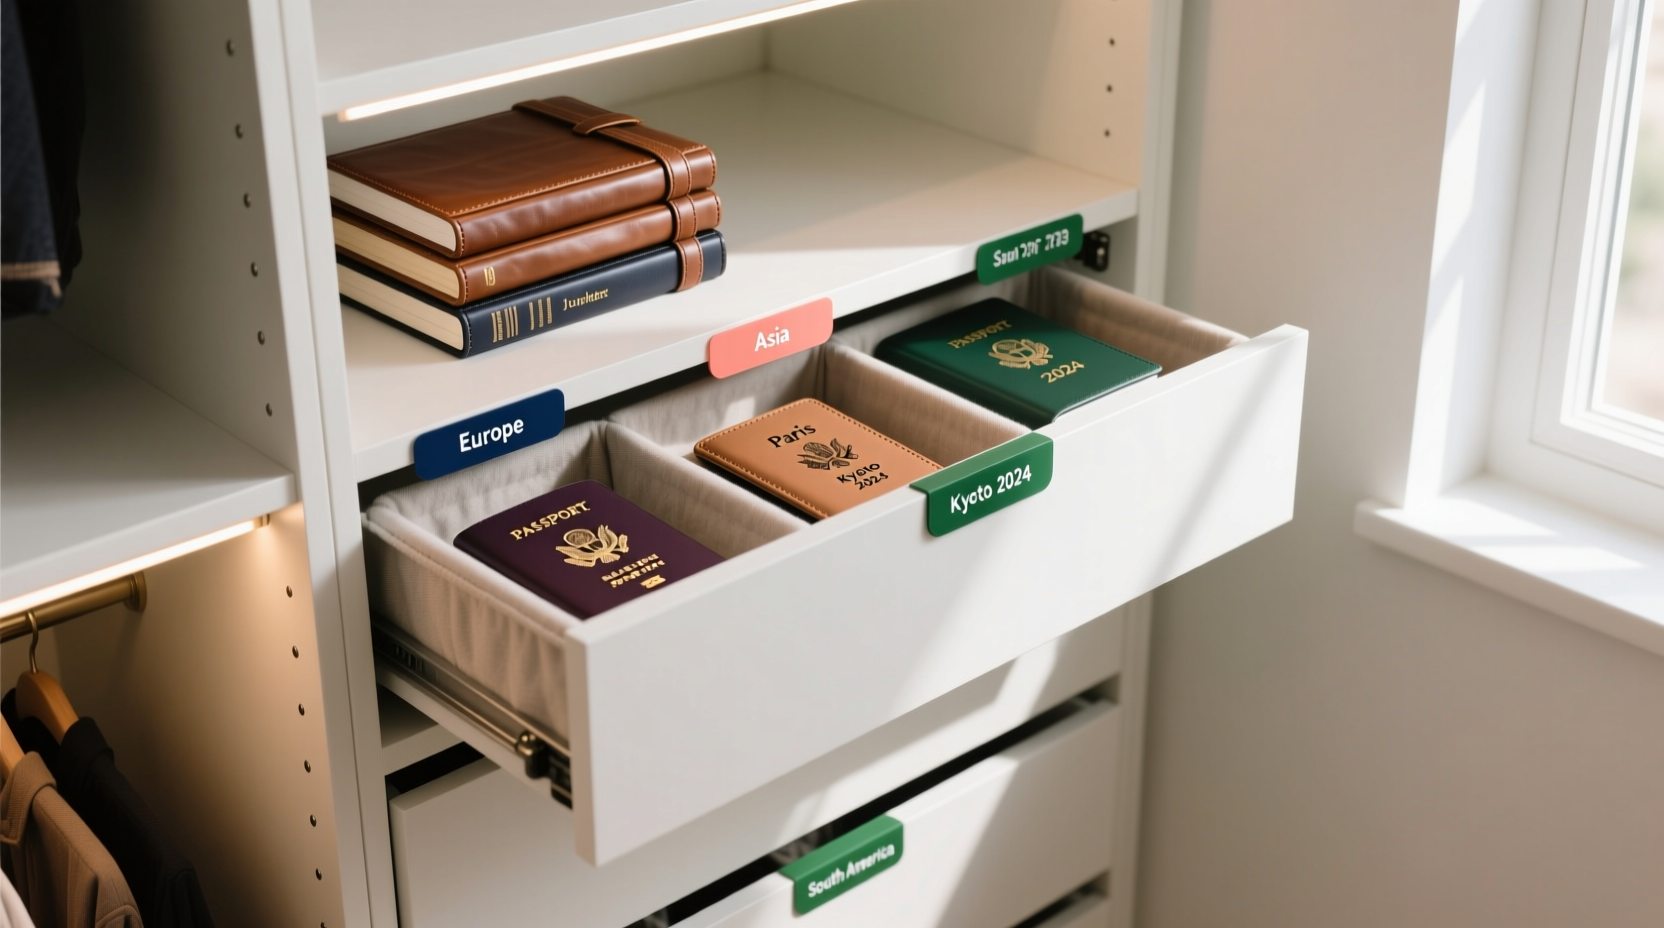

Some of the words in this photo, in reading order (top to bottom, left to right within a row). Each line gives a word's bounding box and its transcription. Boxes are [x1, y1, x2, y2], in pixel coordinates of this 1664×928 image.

[754, 326, 790, 352] Asia
[1040, 360, 1085, 383] 2024
[459, 418, 524, 452] Europe
[767, 425, 816, 448] Paris
[950, 484, 993, 515] Kyoto
[997, 464, 1032, 494] 2024
[509, 500, 591, 540] PASSPORT
[808, 867, 845, 898] South
[846, 844, 895, 879] America
